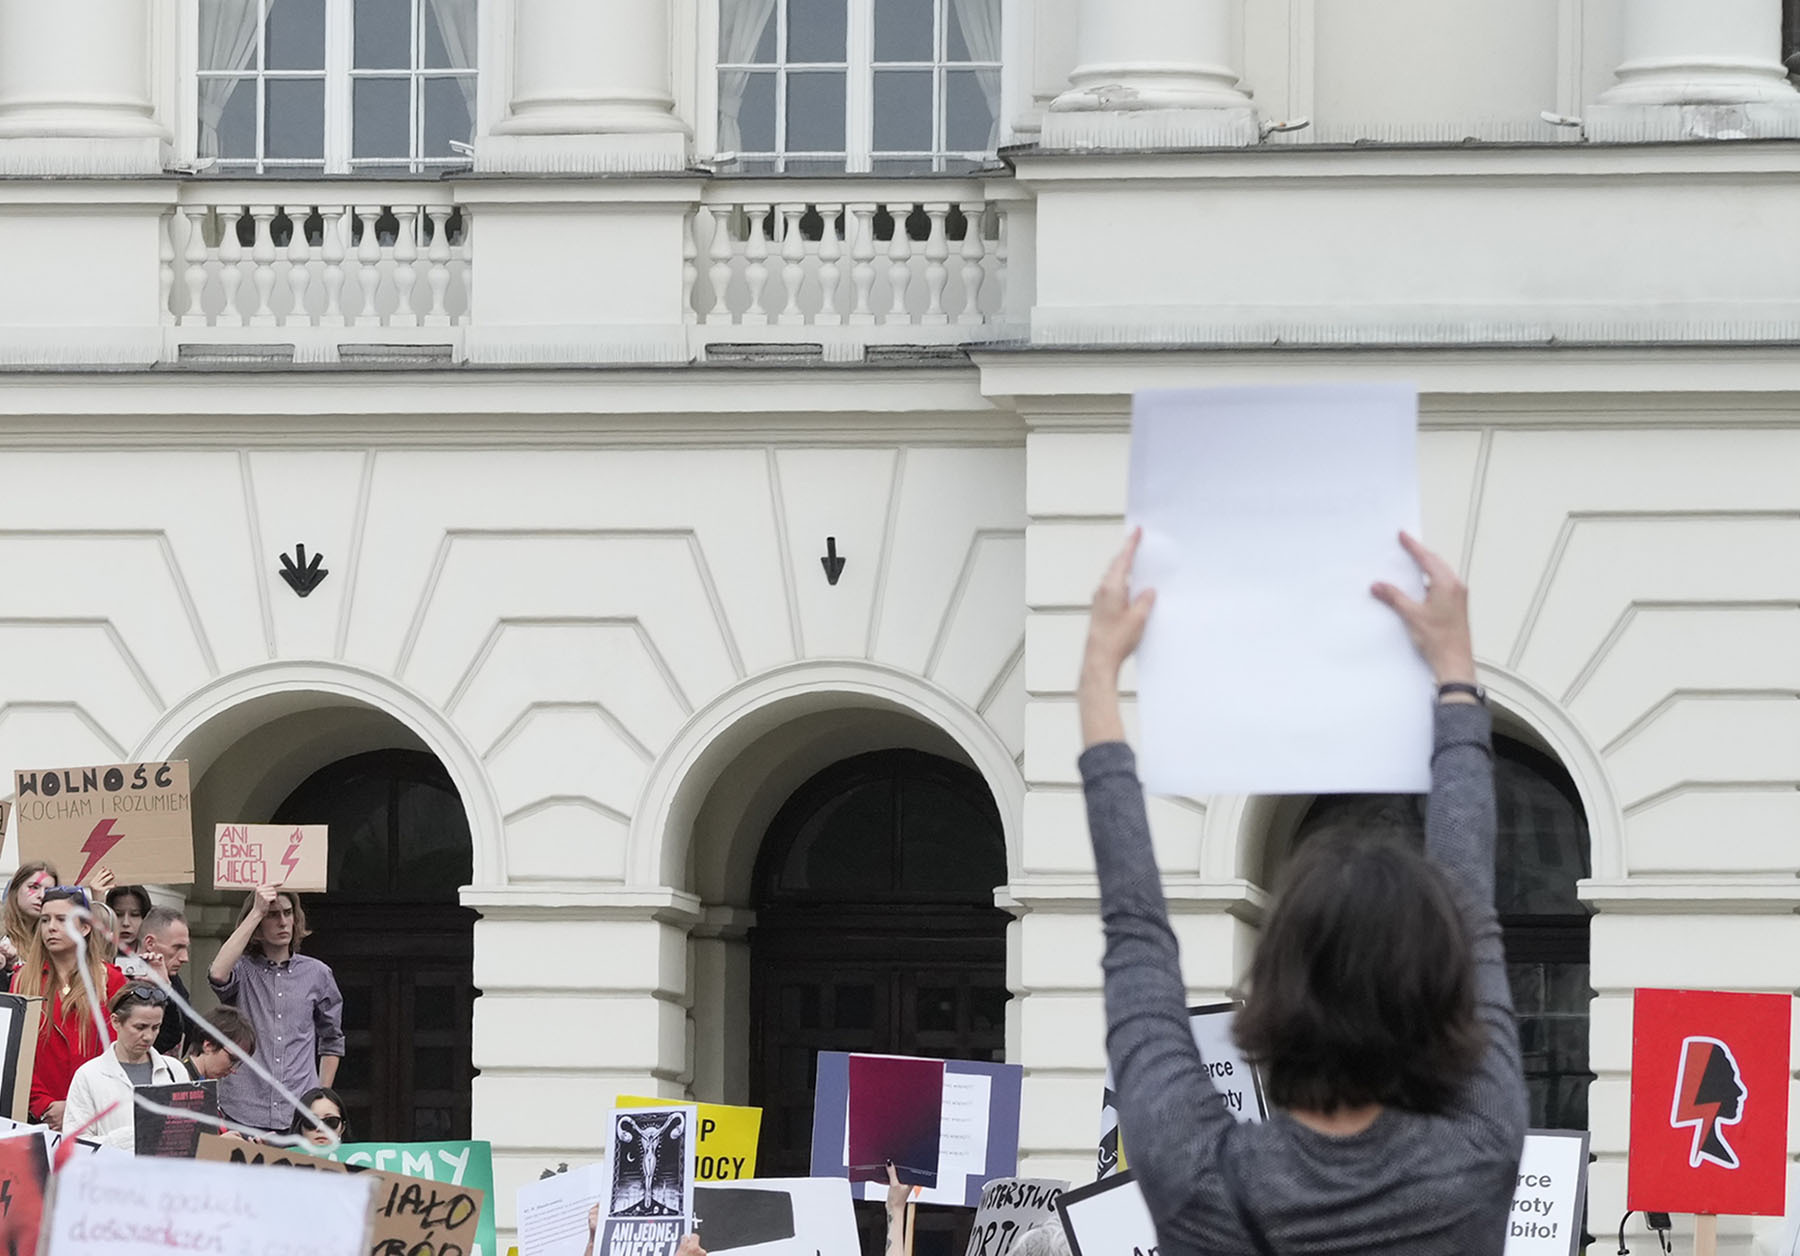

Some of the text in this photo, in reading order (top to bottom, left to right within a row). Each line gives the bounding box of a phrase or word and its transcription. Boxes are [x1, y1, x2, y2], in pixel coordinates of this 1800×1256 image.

[18, 762, 173, 798] WOLNOŚĆ
[19, 793, 190, 823] KOCHAM I ROZUMIEM
[219, 826, 249, 844] ANI
[218, 843, 263, 861] JEDNEJ
[376, 1182, 476, 1230] IAŁO
[611, 1222, 679, 1242] ANI JEDNEJ
[1510, 1221, 1558, 1239] biło!
